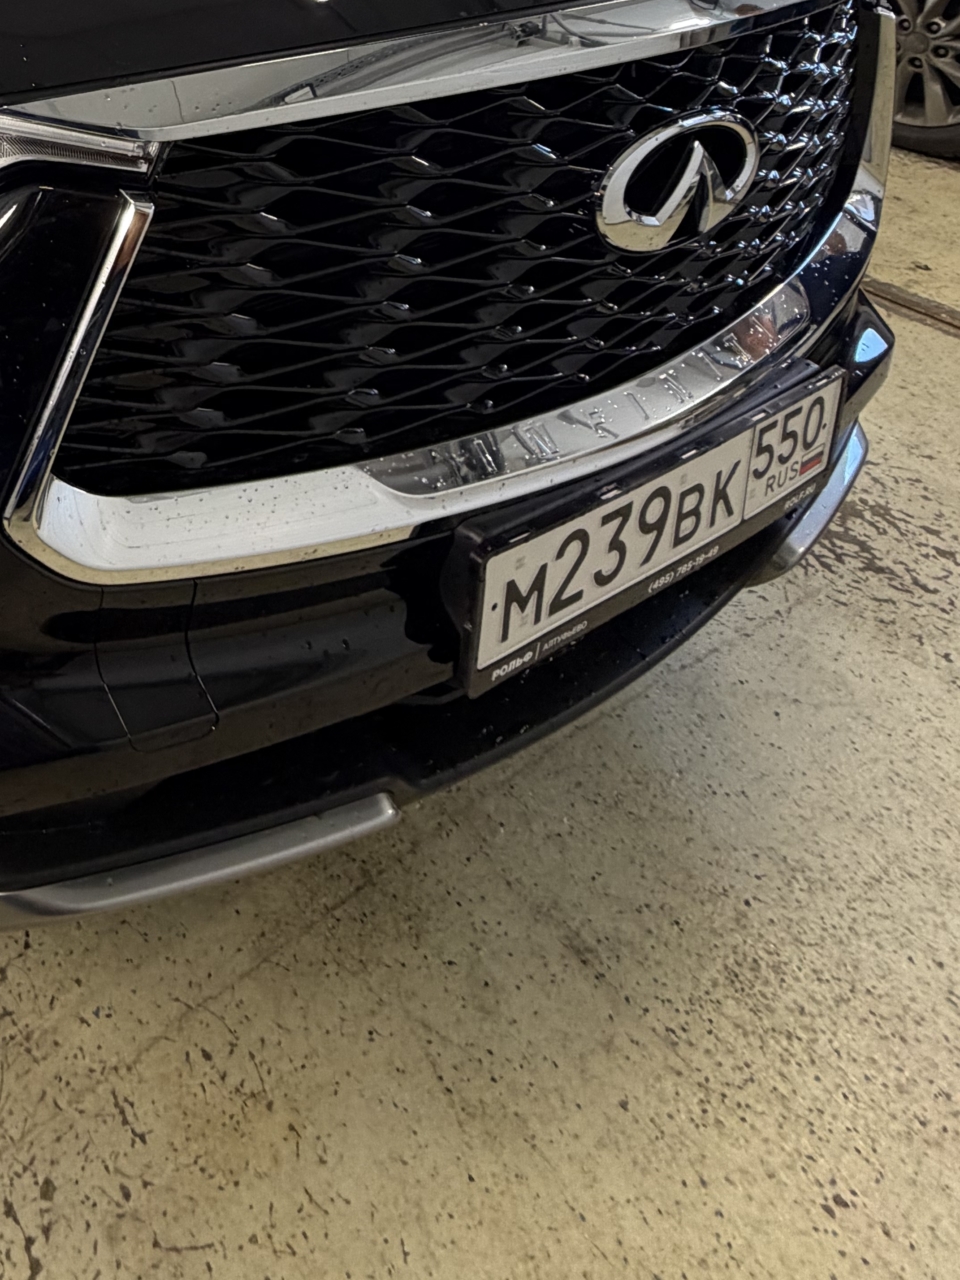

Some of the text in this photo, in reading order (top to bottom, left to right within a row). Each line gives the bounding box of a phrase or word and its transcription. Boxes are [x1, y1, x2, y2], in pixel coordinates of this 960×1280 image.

[752, 395, 825, 481] 550
[764, 460, 800, 497] RUS
[491, 651, 534, 682] РОЛЬФ
